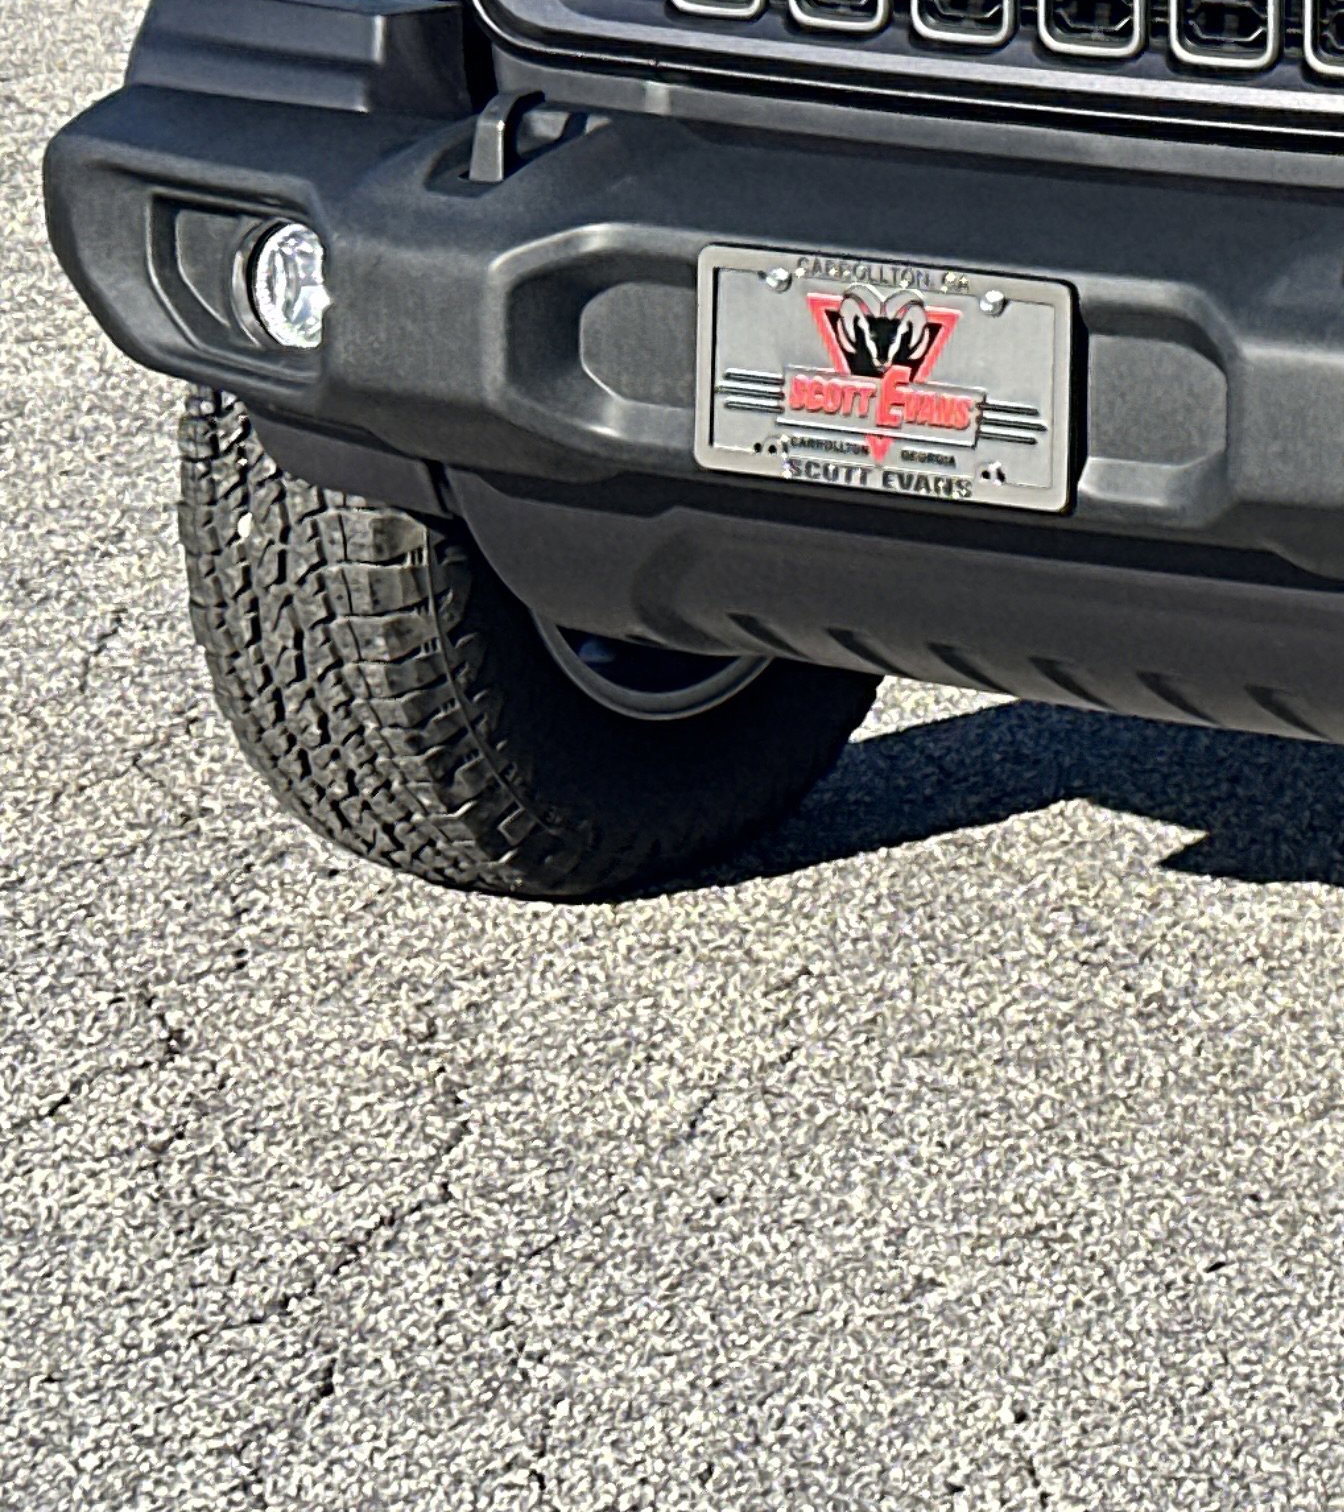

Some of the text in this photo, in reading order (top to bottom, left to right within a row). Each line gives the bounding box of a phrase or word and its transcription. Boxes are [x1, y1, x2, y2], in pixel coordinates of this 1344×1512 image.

[788, 364, 973, 431] SCOTT EVANS
[788, 457, 973, 499] SCOTT EVANS
